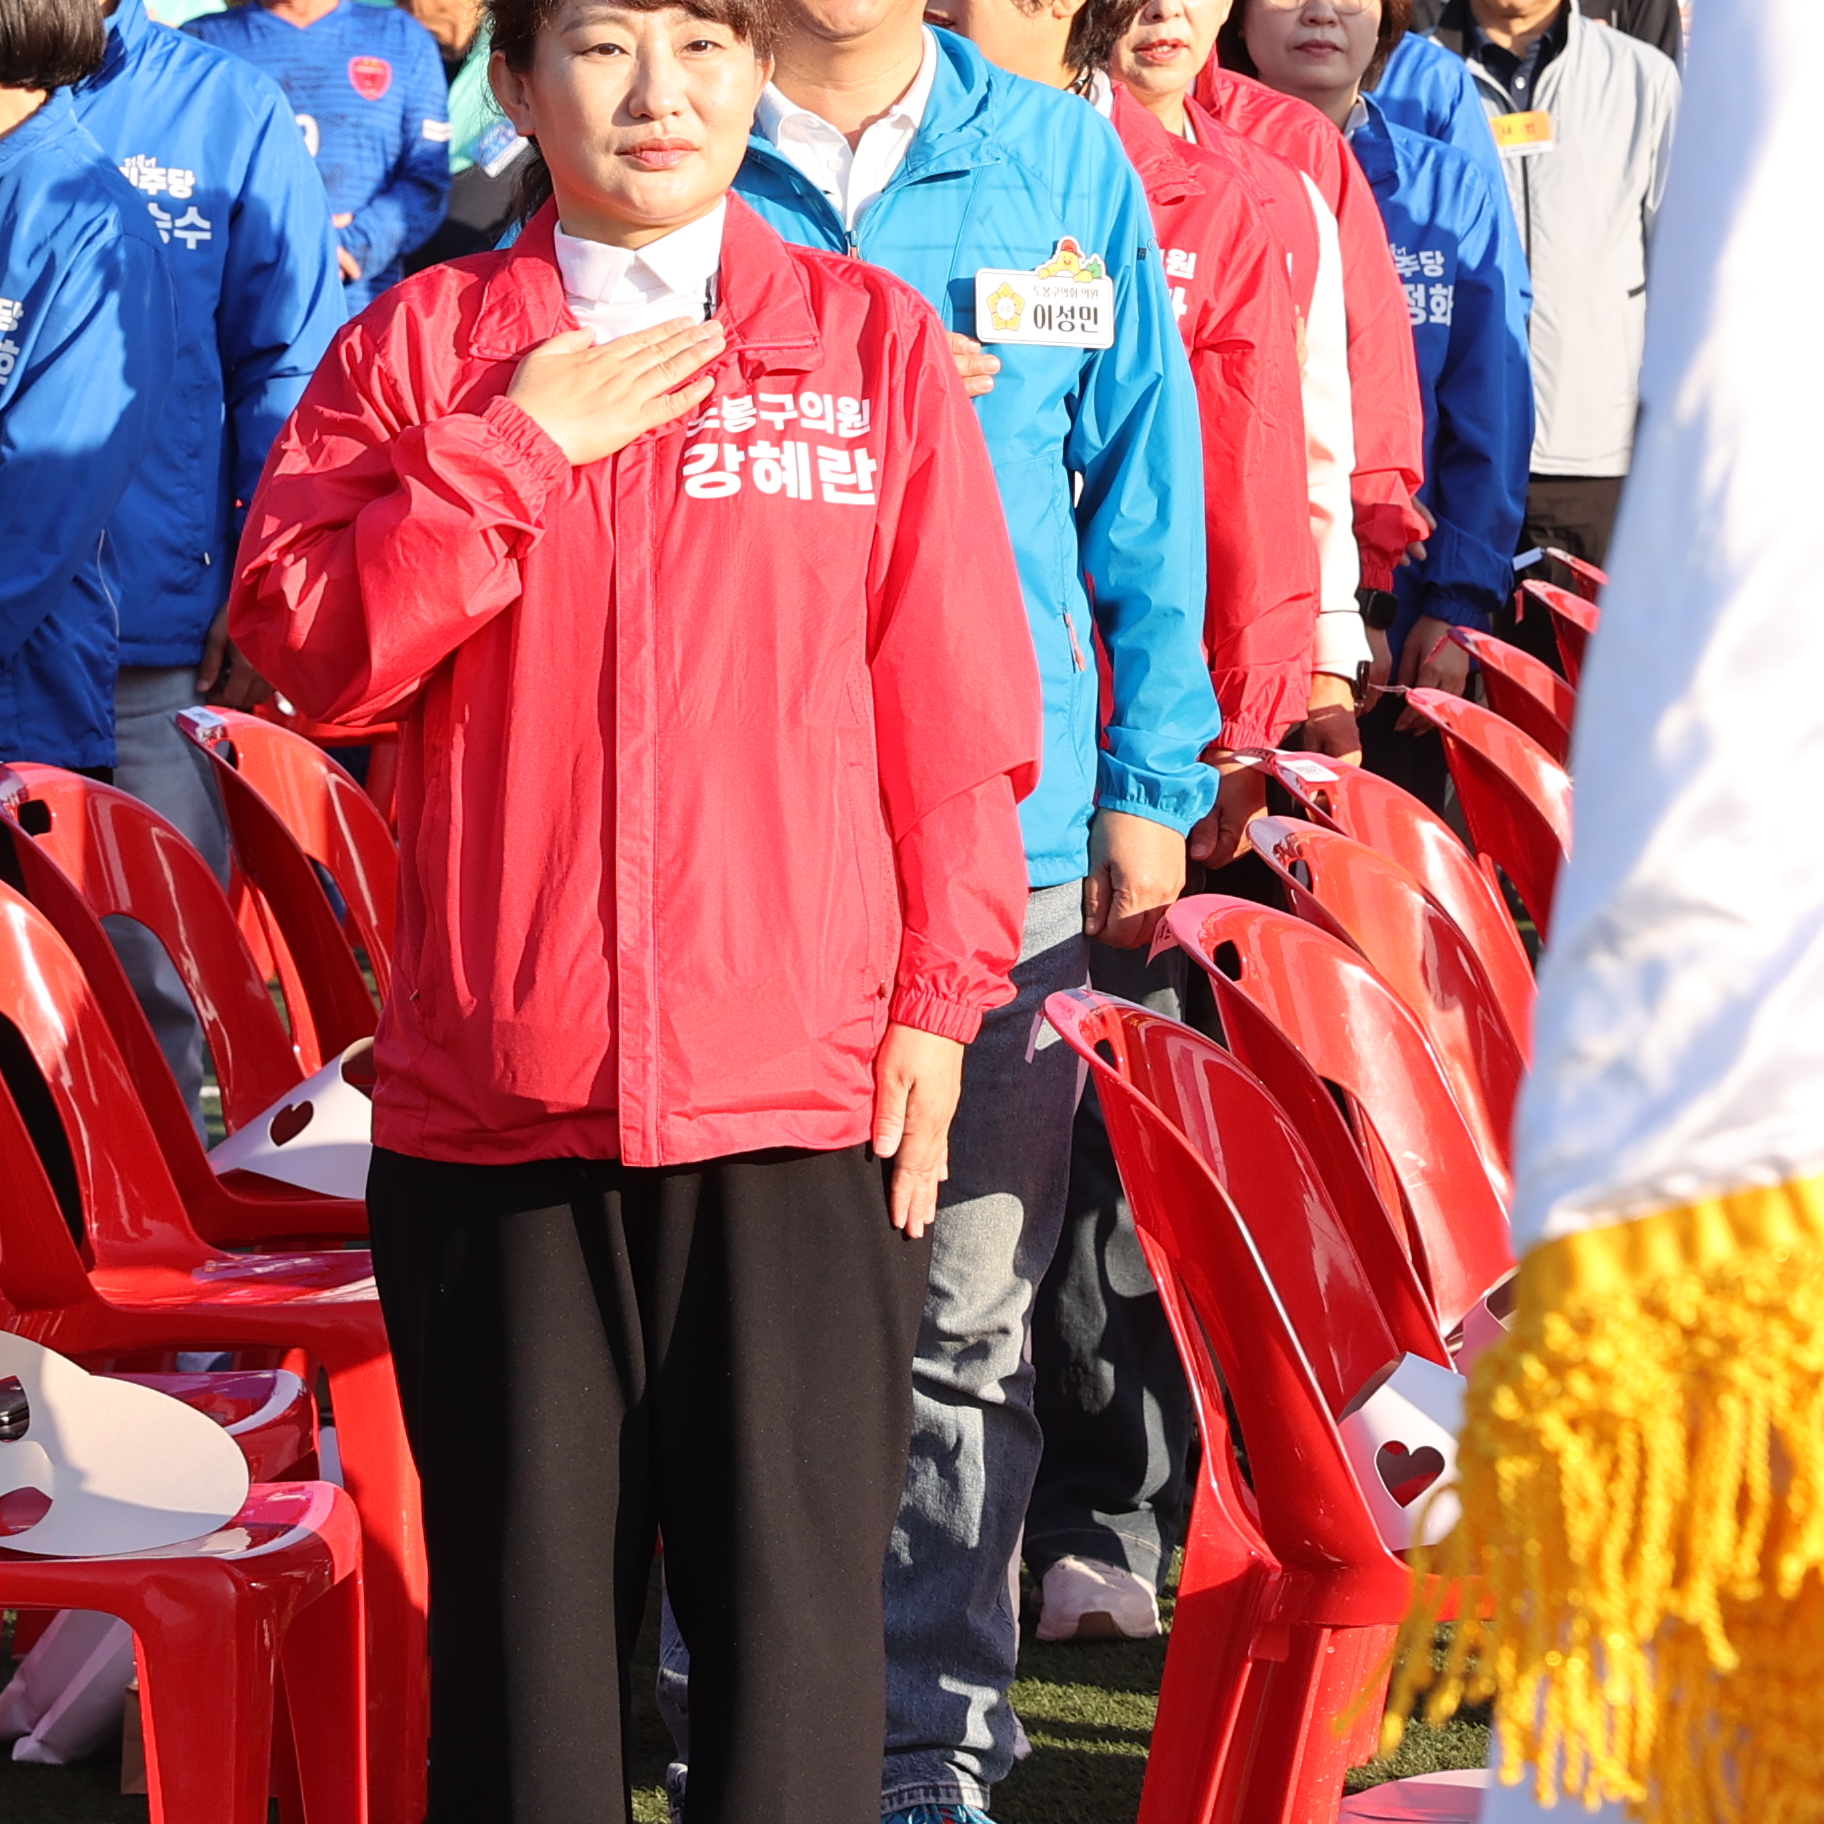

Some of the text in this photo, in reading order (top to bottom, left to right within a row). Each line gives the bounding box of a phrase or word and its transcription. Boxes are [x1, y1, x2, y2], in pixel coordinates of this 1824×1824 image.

[1161, 248, 1198, 280] 원
[1395, 250, 1445, 278] 주당
[1033, 285, 1099, 300] 도봉구의회 의원
[1404, 283, 1455, 327] 정화
[1033, 303, 1099, 334] 이성민
[682, 439, 877, 505] 강혜란
